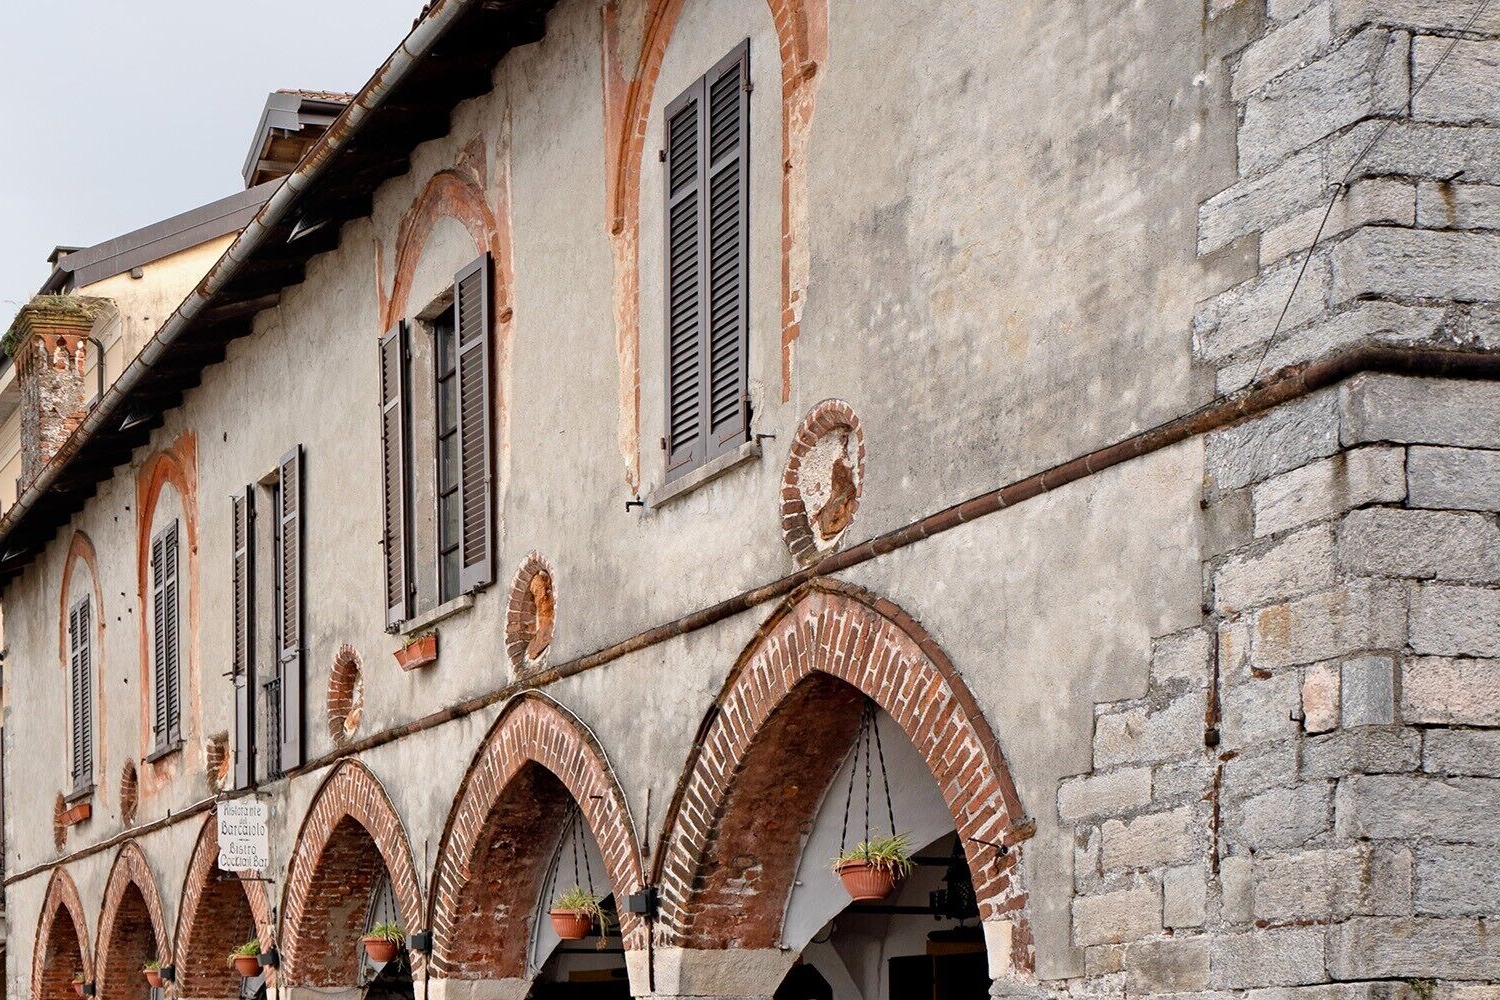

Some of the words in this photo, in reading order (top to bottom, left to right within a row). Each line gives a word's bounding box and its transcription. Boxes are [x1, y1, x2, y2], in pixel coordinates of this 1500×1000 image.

[224, 804, 261, 816] Ristorante
[221, 820, 265, 835] Barcaiolo
[253, 855, 267, 867] Bar
